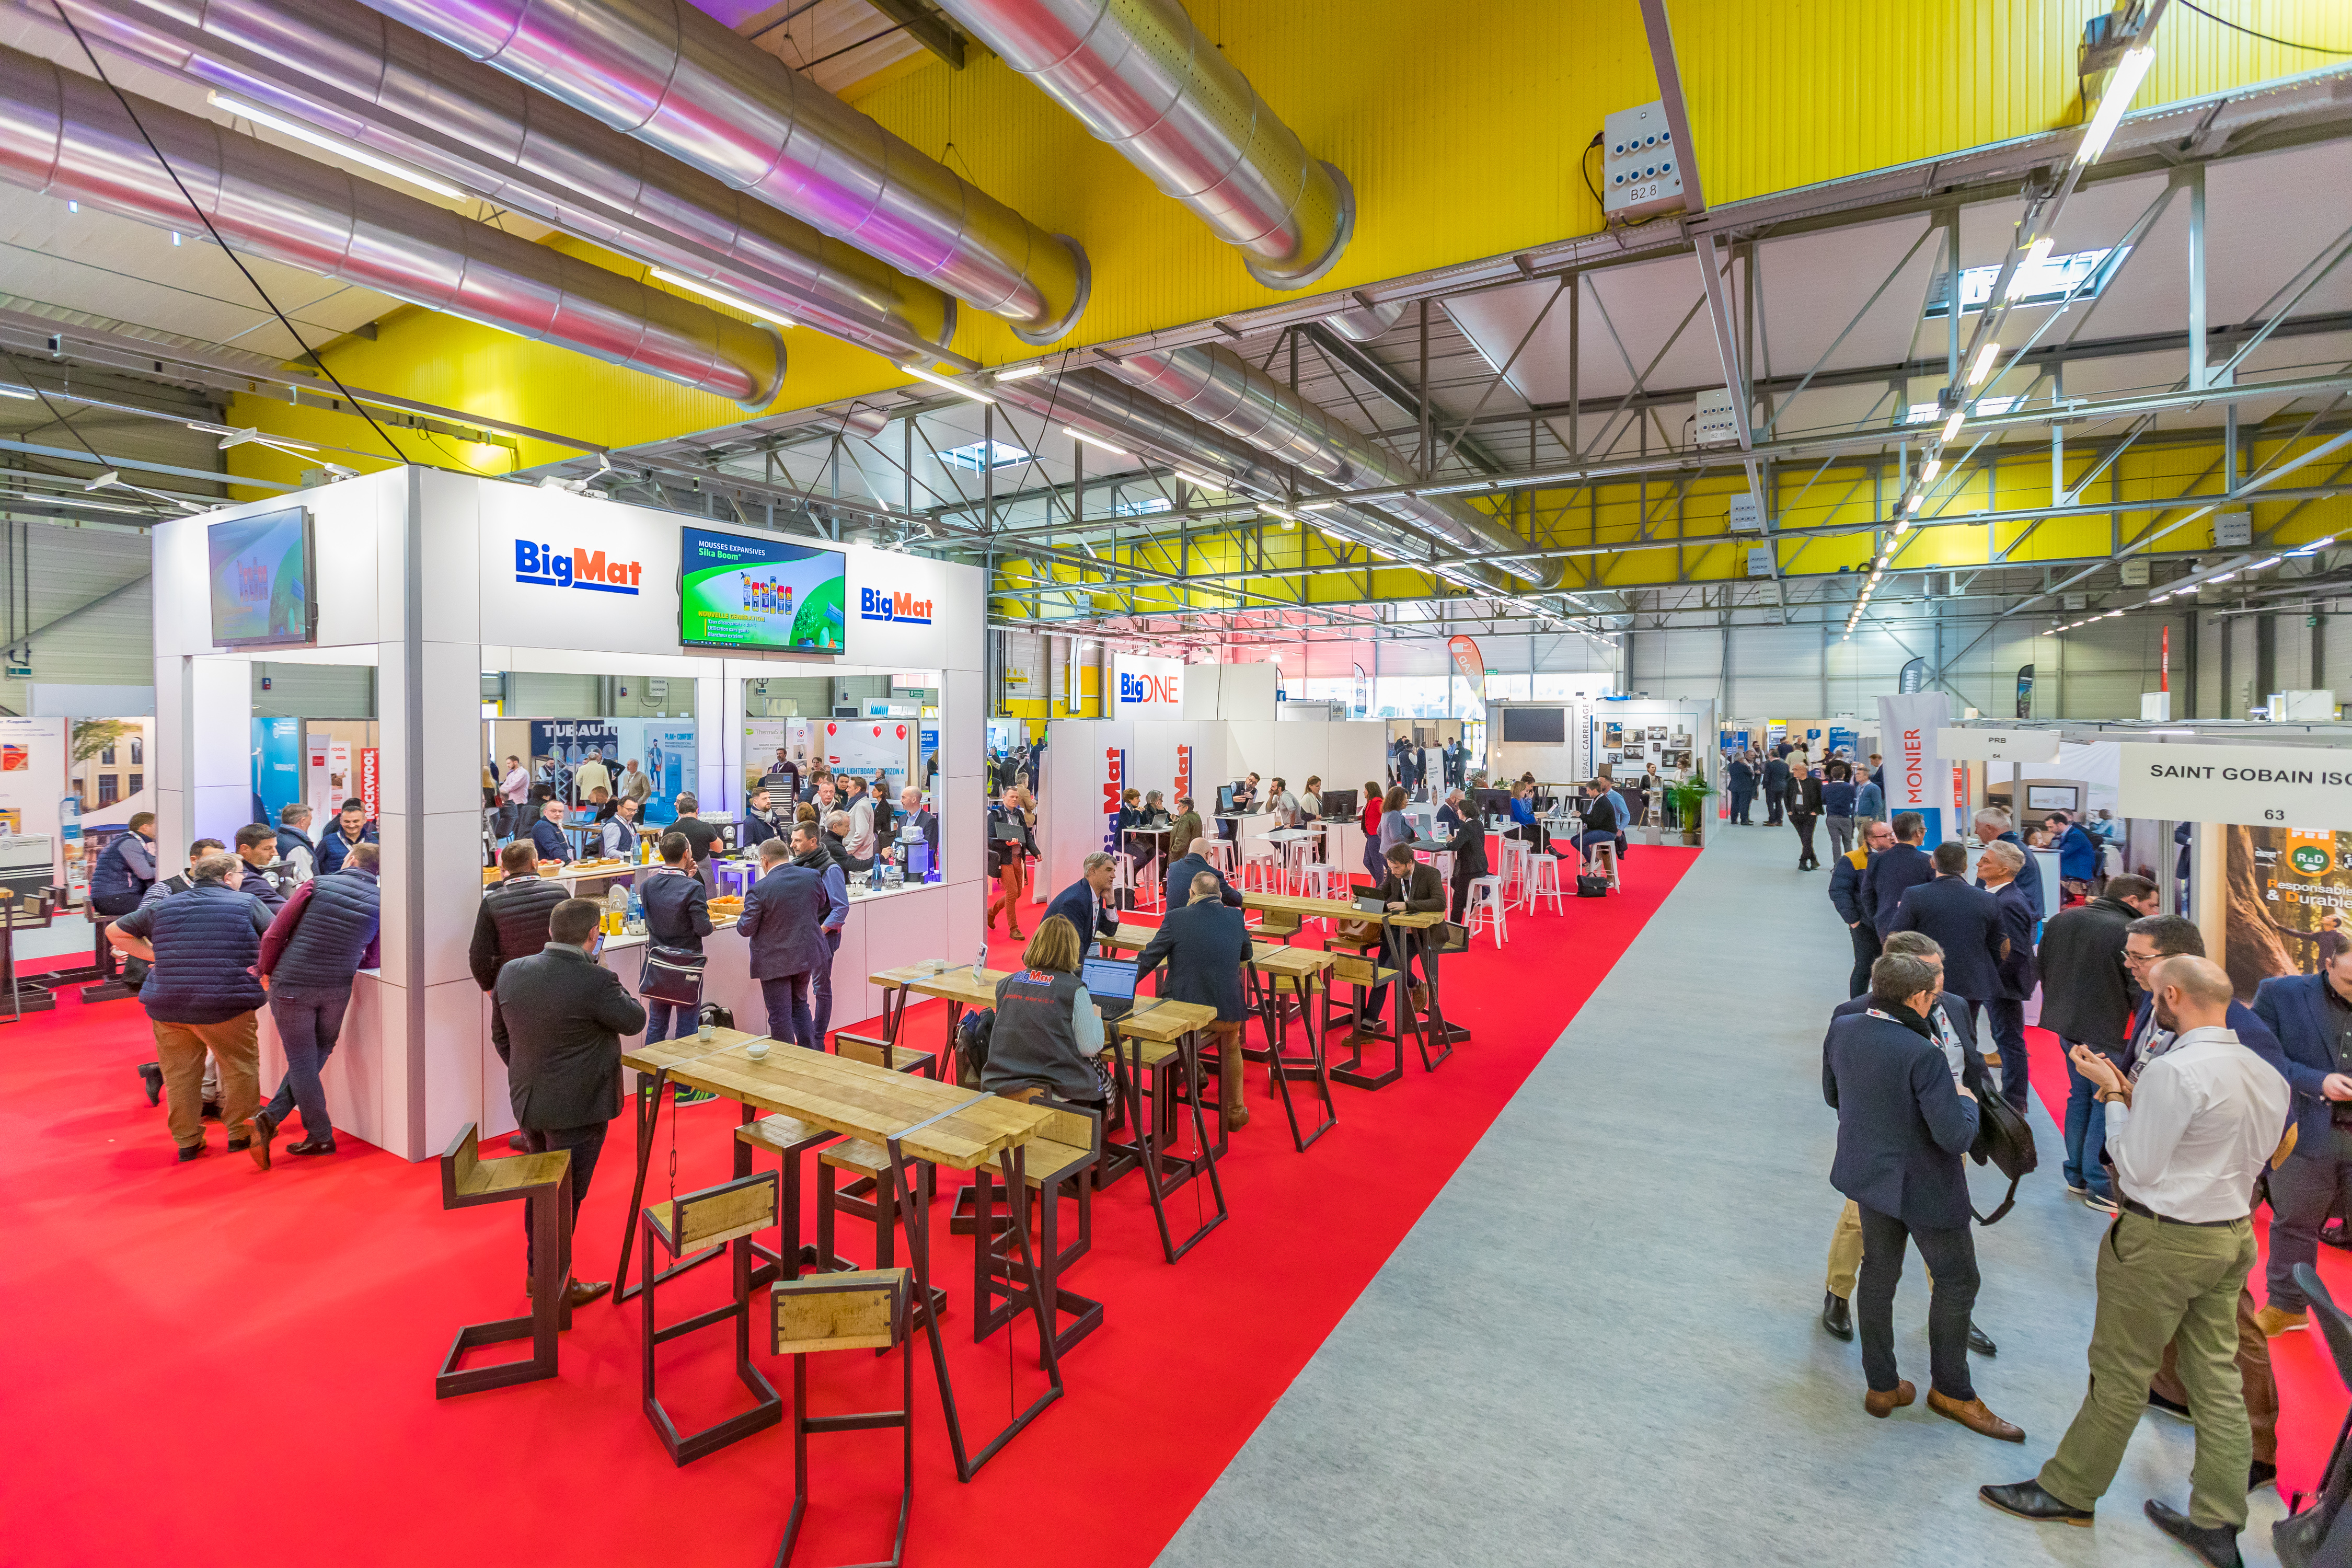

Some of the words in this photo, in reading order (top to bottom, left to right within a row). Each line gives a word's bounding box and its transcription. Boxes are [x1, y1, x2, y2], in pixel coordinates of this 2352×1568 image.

[1631, 185, 1657, 201] B2.8
[698, 540, 728, 550] MOUSSES
[729, 545, 766, 556] EXPANSIVES
[698, 547, 716, 558] Sika
[515, 539, 642, 587] BigMat
[861, 587, 933, 621] BigMat
[698, 610, 729, 619] NOUVELLE
[730, 613, 765, 622] GÉNÉRATION
[1904, 728, 1923, 804] MONIER
[2150, 764, 2215, 780] SAINT
[2222, 767, 2313, 784] GOBAIN
[364, 750, 375, 820] ROCKWOOL
[2264, 809, 2285, 821] 63
[2297, 853, 2324, 864] R&D
[2267, 879, 2352, 896] Responsable
[2266, 890, 2280, 901] &
[2286, 891, 2352, 908] Durable
[1013, 970, 1054, 983] BigMat
[1025, 996, 1055, 1004] service
